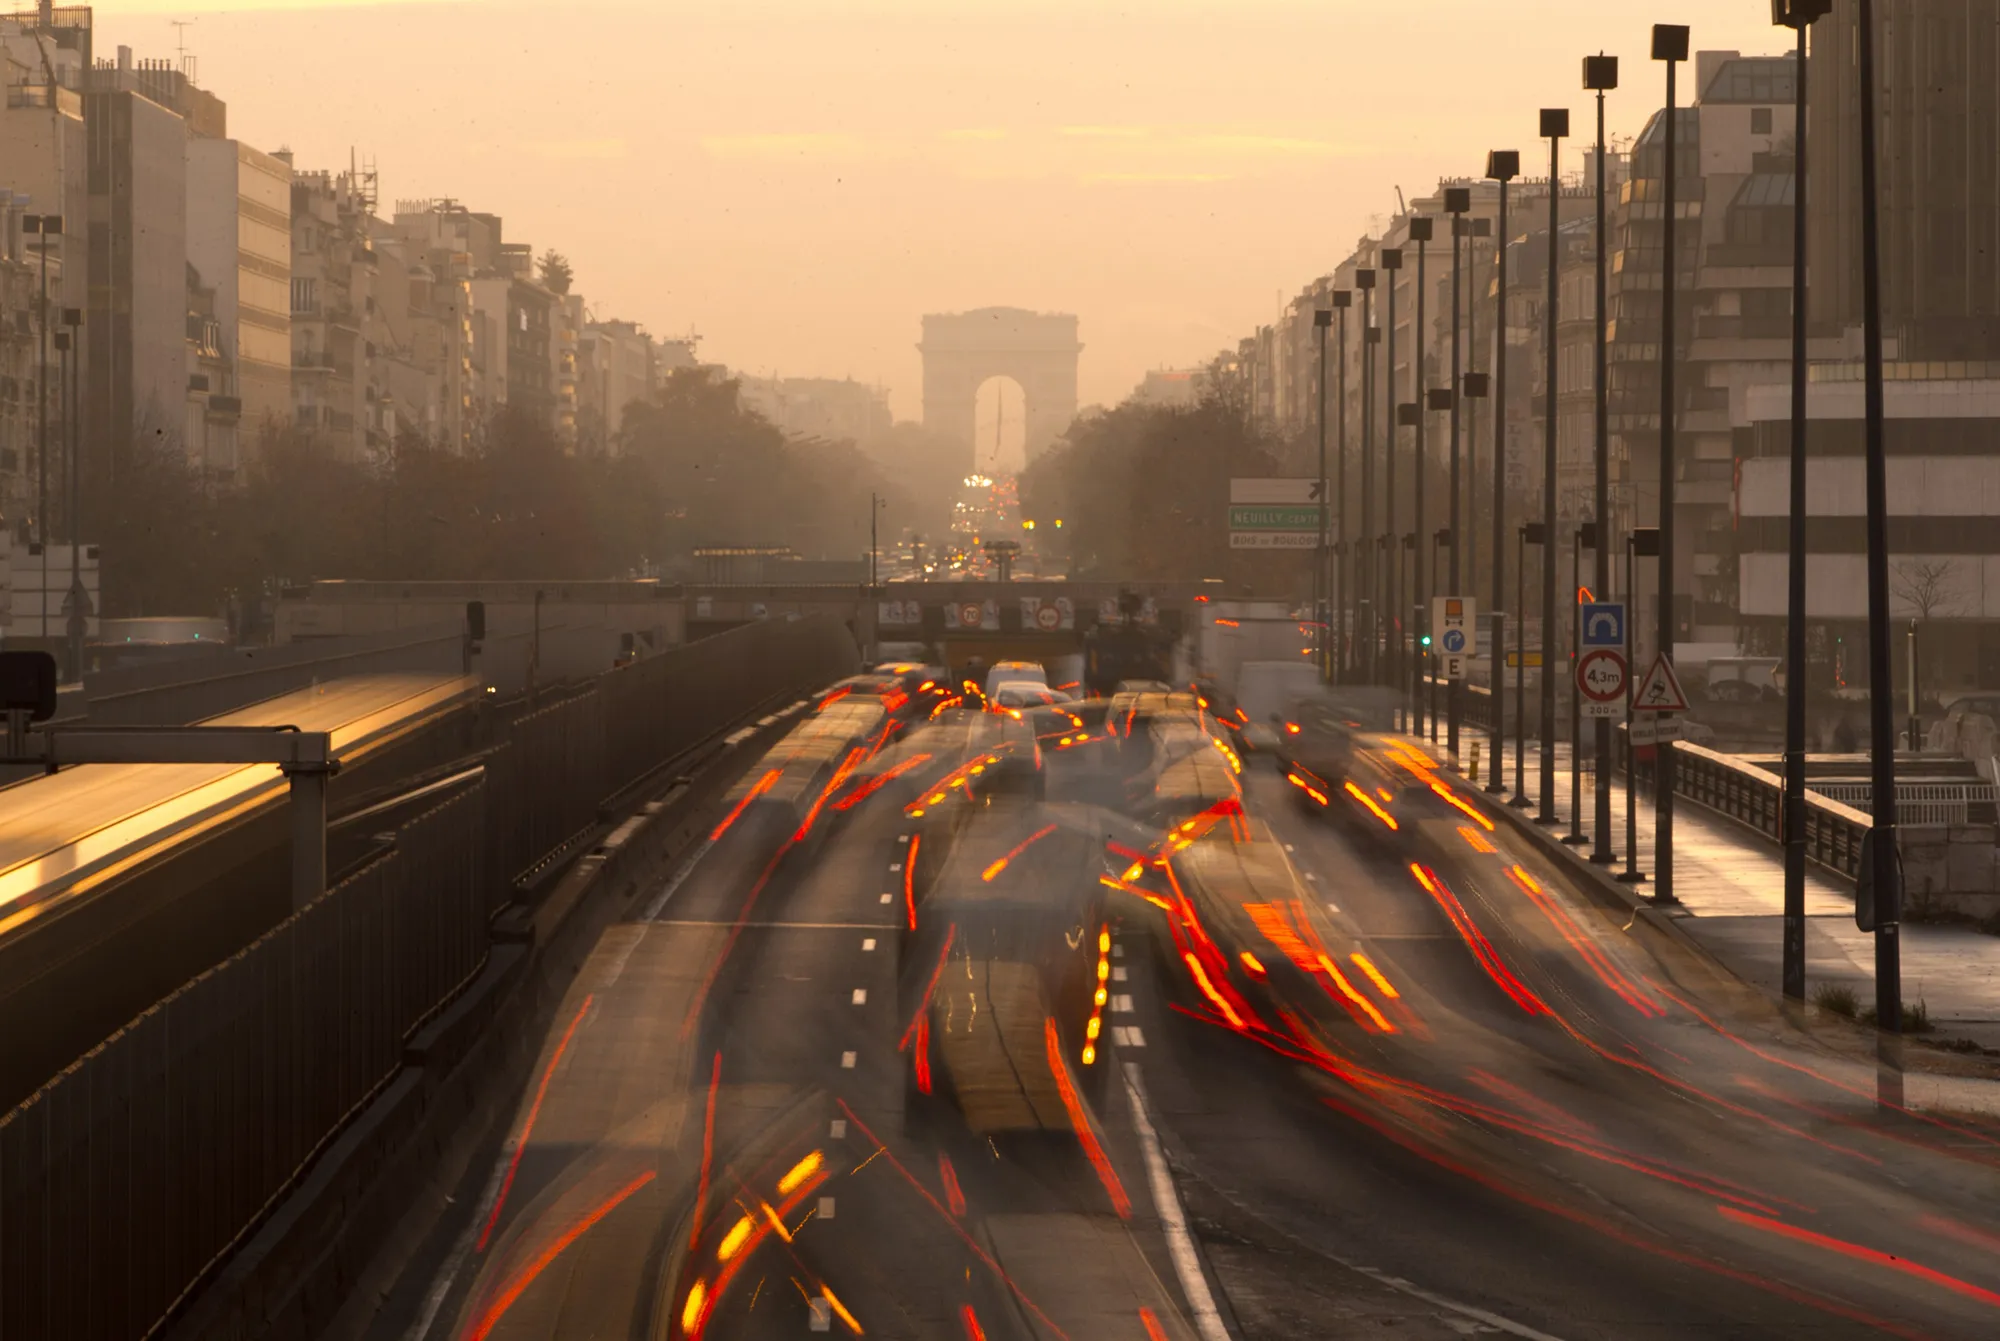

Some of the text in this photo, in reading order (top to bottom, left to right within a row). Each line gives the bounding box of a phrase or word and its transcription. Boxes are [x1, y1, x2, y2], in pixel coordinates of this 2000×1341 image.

[1234, 511, 1320, 524] NEUILLY CENTR
[1233, 535, 1258, 545] BOIS
[966, 610, 977, 620] 70
[1449, 659, 1460, 675] E
[1587, 669, 1620, 684] 4,3m
[1590, 706, 1609, 714] 200
